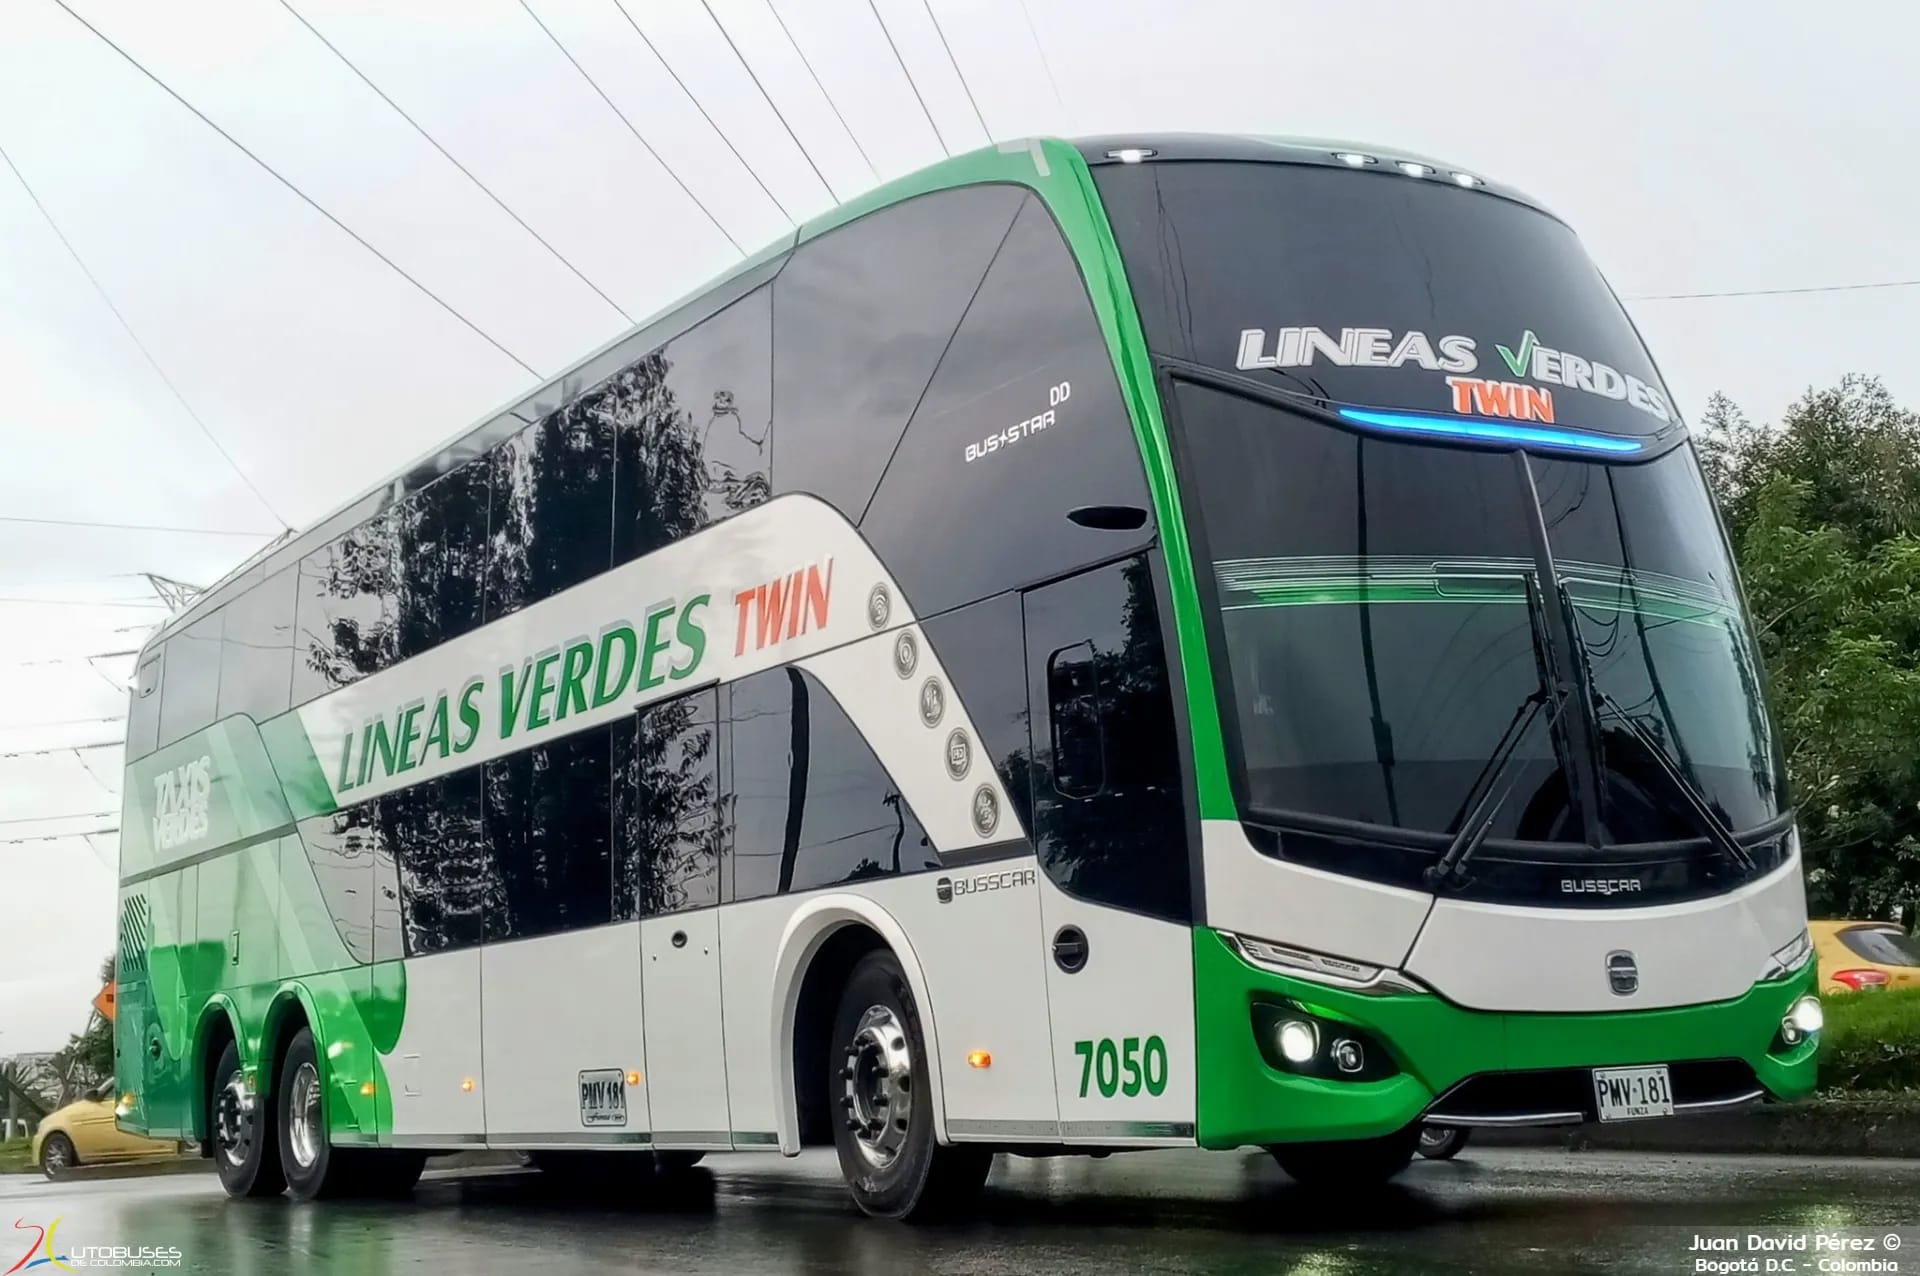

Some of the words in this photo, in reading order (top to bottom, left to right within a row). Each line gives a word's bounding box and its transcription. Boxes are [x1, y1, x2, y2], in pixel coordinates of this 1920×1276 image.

[1050, 381, 1071, 407] DD
[1235, 327, 1478, 371] LINEAS
[1495, 329, 1671, 421] VERDES
[1446, 375, 1555, 424] TWIN
[337, 674, 485, 794] LINEAS
[500, 593, 711, 739] VERDES
[733, 553, 834, 658] TWIN
[954, 869, 1037, 896] BUSSCAR
[1560, 879, 1641, 895] BUSSCAR
[1074, 1034, 1168, 1099] 7050
